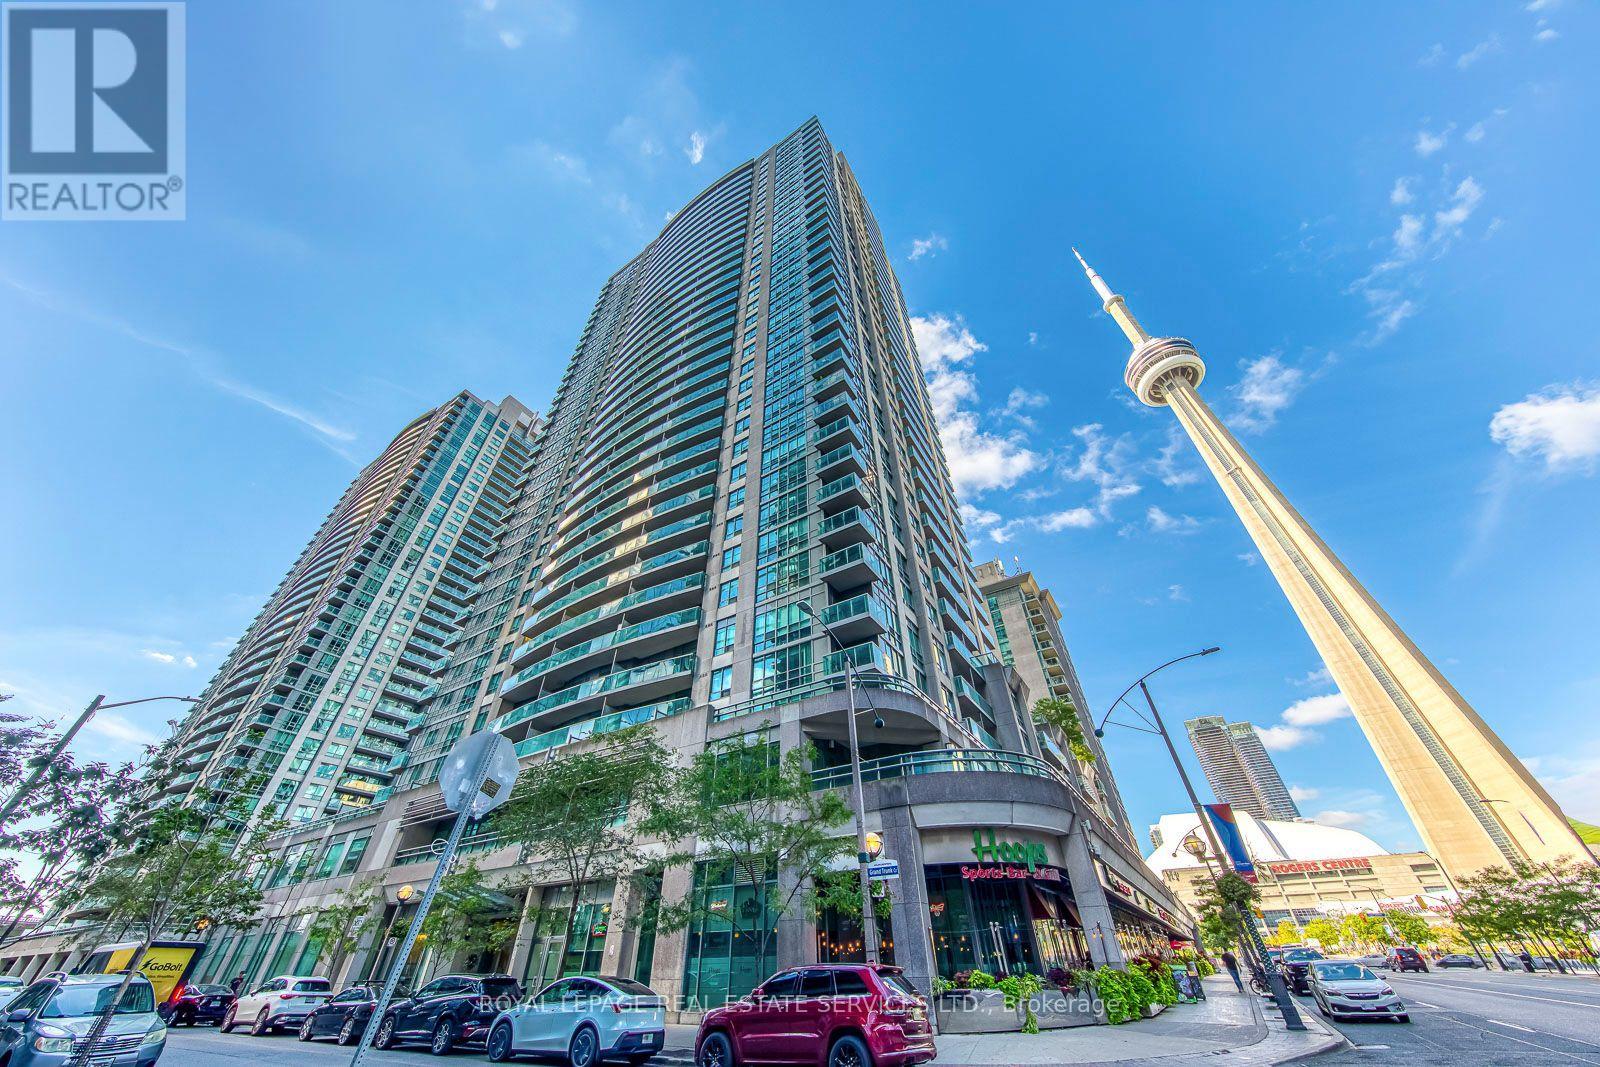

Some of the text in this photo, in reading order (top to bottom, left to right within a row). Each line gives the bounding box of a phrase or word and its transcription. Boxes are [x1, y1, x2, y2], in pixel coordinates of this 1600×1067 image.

[971, 828, 1049, 874] Hoops
[961, 865, 1003, 882] Sports
[1006, 864, 1027, 879] Bar
[1271, 858, 1372, 874] ROGERS CENTRE
